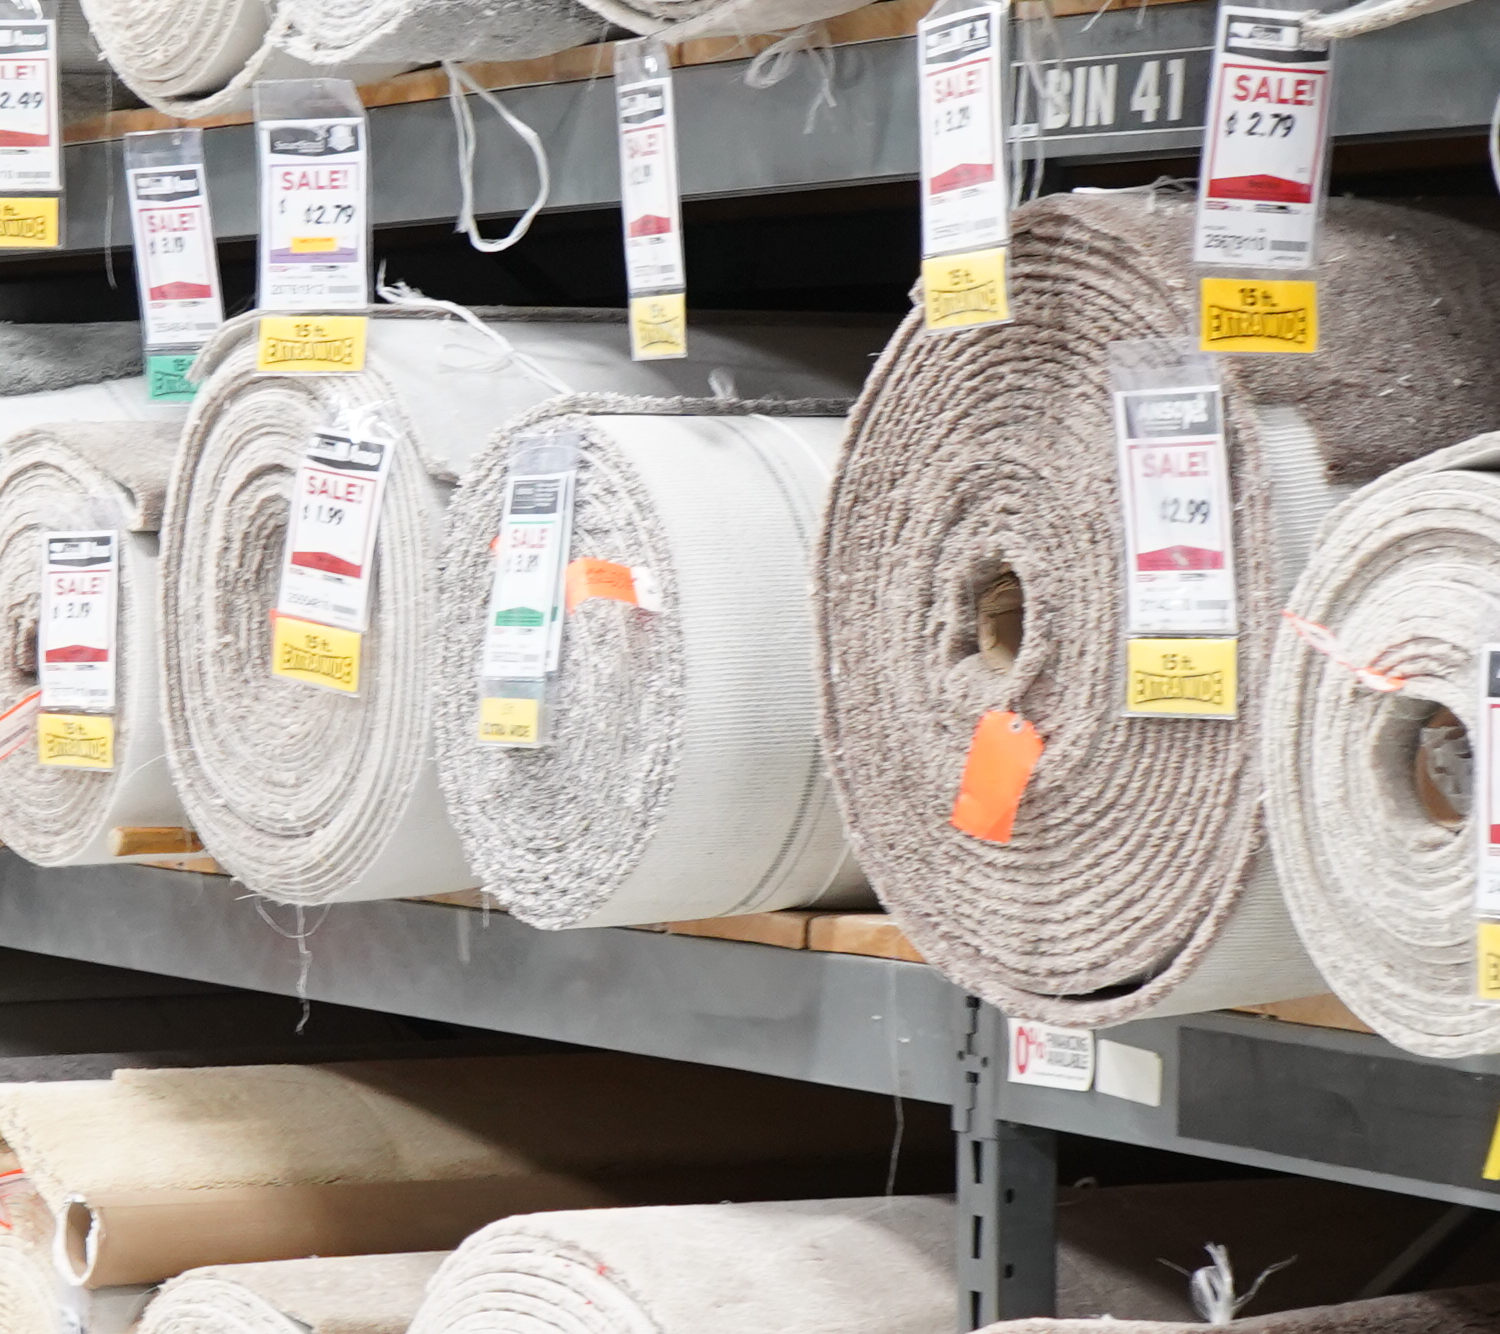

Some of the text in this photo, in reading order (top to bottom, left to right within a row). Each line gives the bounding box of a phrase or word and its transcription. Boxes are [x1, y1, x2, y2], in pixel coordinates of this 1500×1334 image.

[1042, 58, 1186, 130] BIN 41
[1233, 74, 1317, 106] SALE!
[1247, 113, 1295, 138] 2.79
[281, 170, 348, 191] SALE!
[1238, 287, 1257, 307] 15
[294, 324, 311, 338] 15
[1143, 452, 1209, 478] SALE!
[305, 476, 365, 505] SALE!
[55, 577, 104, 596] SALE!
